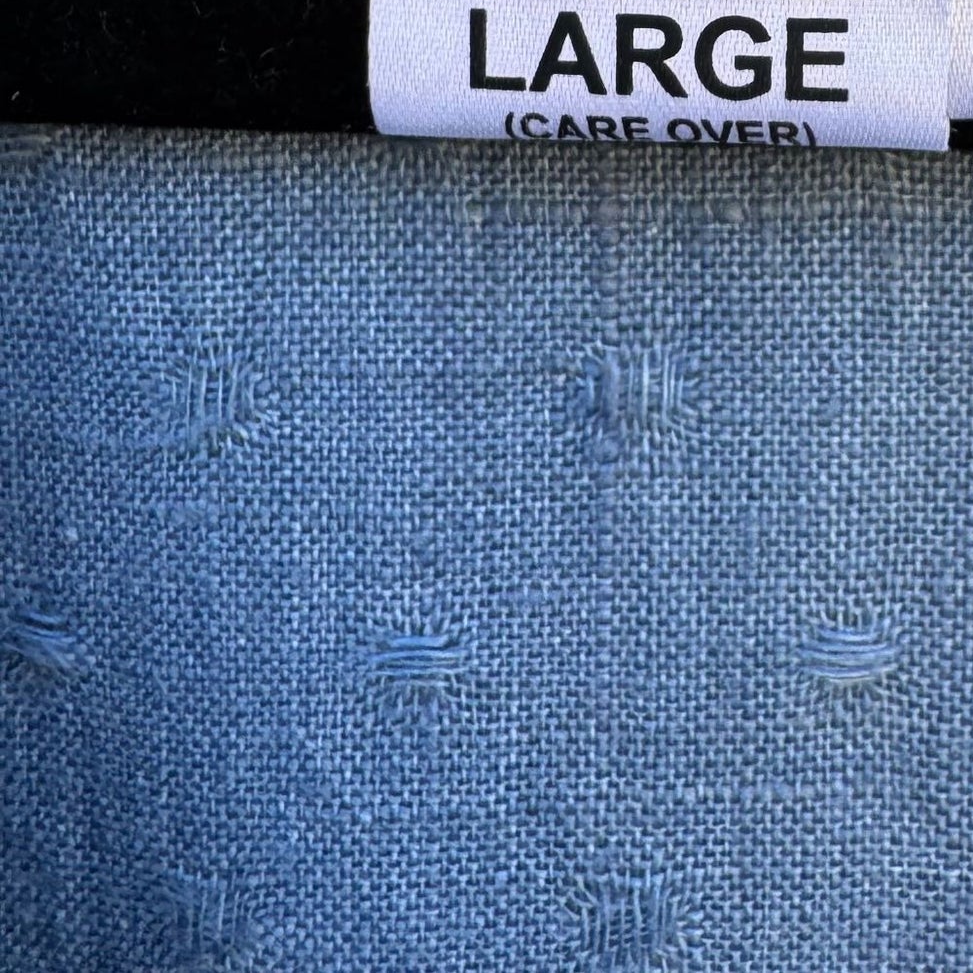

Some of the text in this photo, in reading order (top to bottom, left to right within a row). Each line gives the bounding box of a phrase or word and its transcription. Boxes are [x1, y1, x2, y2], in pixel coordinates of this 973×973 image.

[469, 8, 850, 102] LARGE
[504, 111, 816, 147] (CARE OVER)
